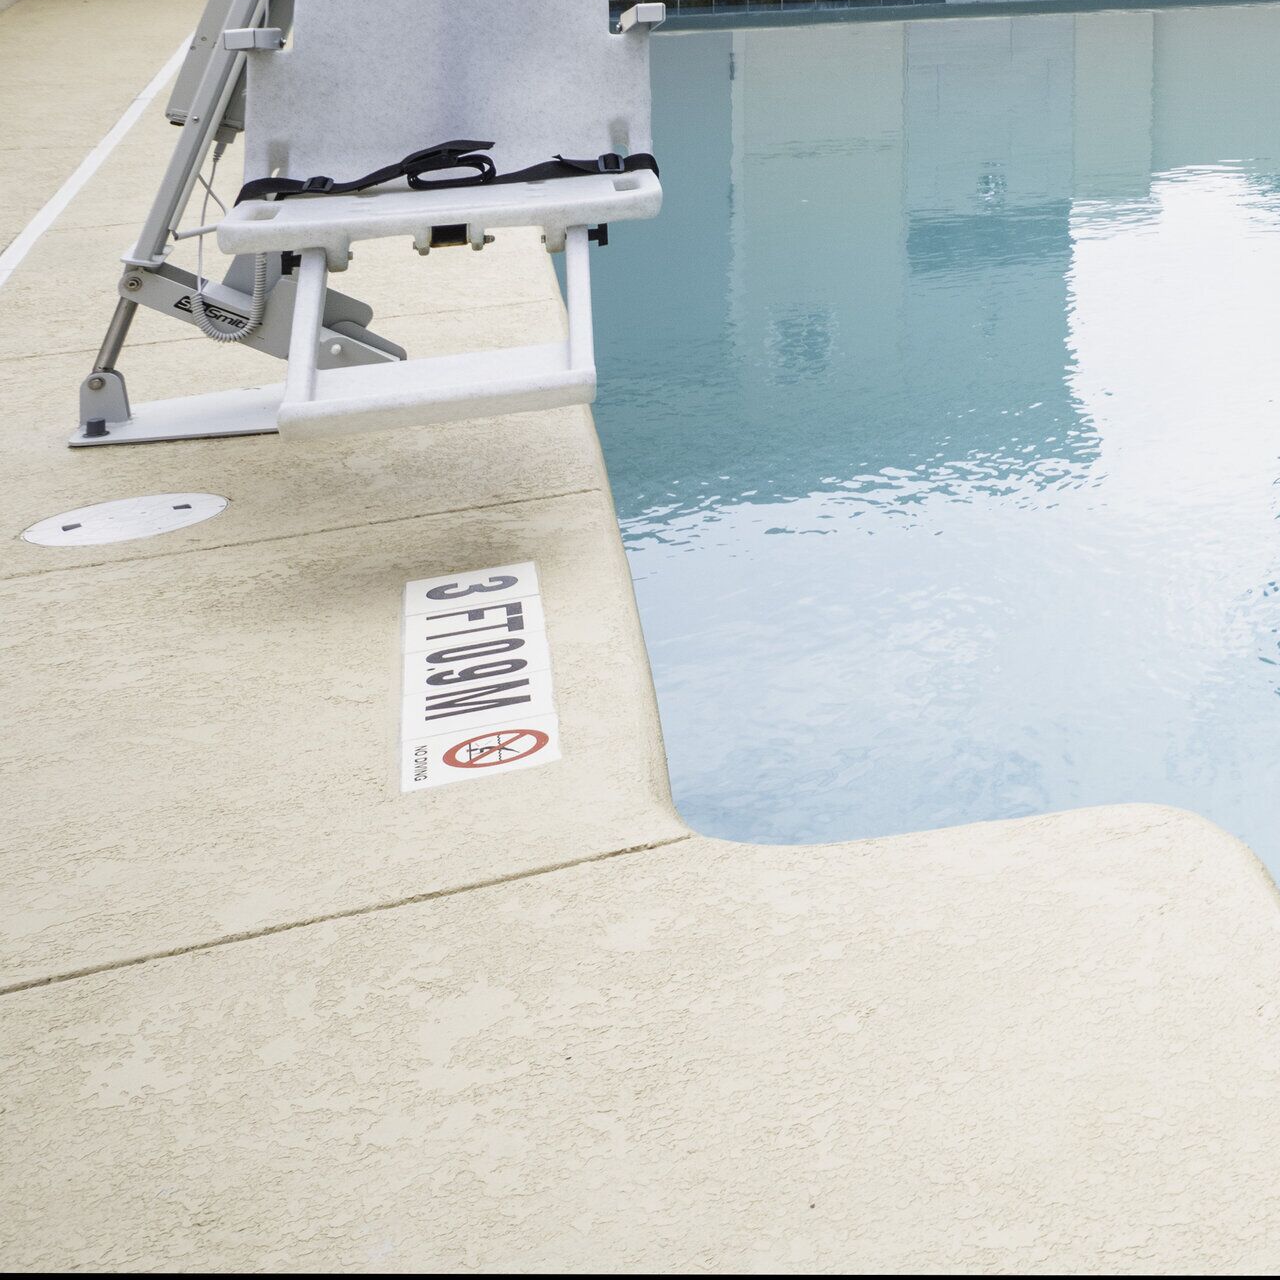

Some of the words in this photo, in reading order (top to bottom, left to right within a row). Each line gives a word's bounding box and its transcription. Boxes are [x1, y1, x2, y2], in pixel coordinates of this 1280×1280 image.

[425, 575, 519, 600] 3
[426, 601, 524, 641] FT
[414, 744, 428, 757] NO
[414, 756, 428, 782] DIVING
